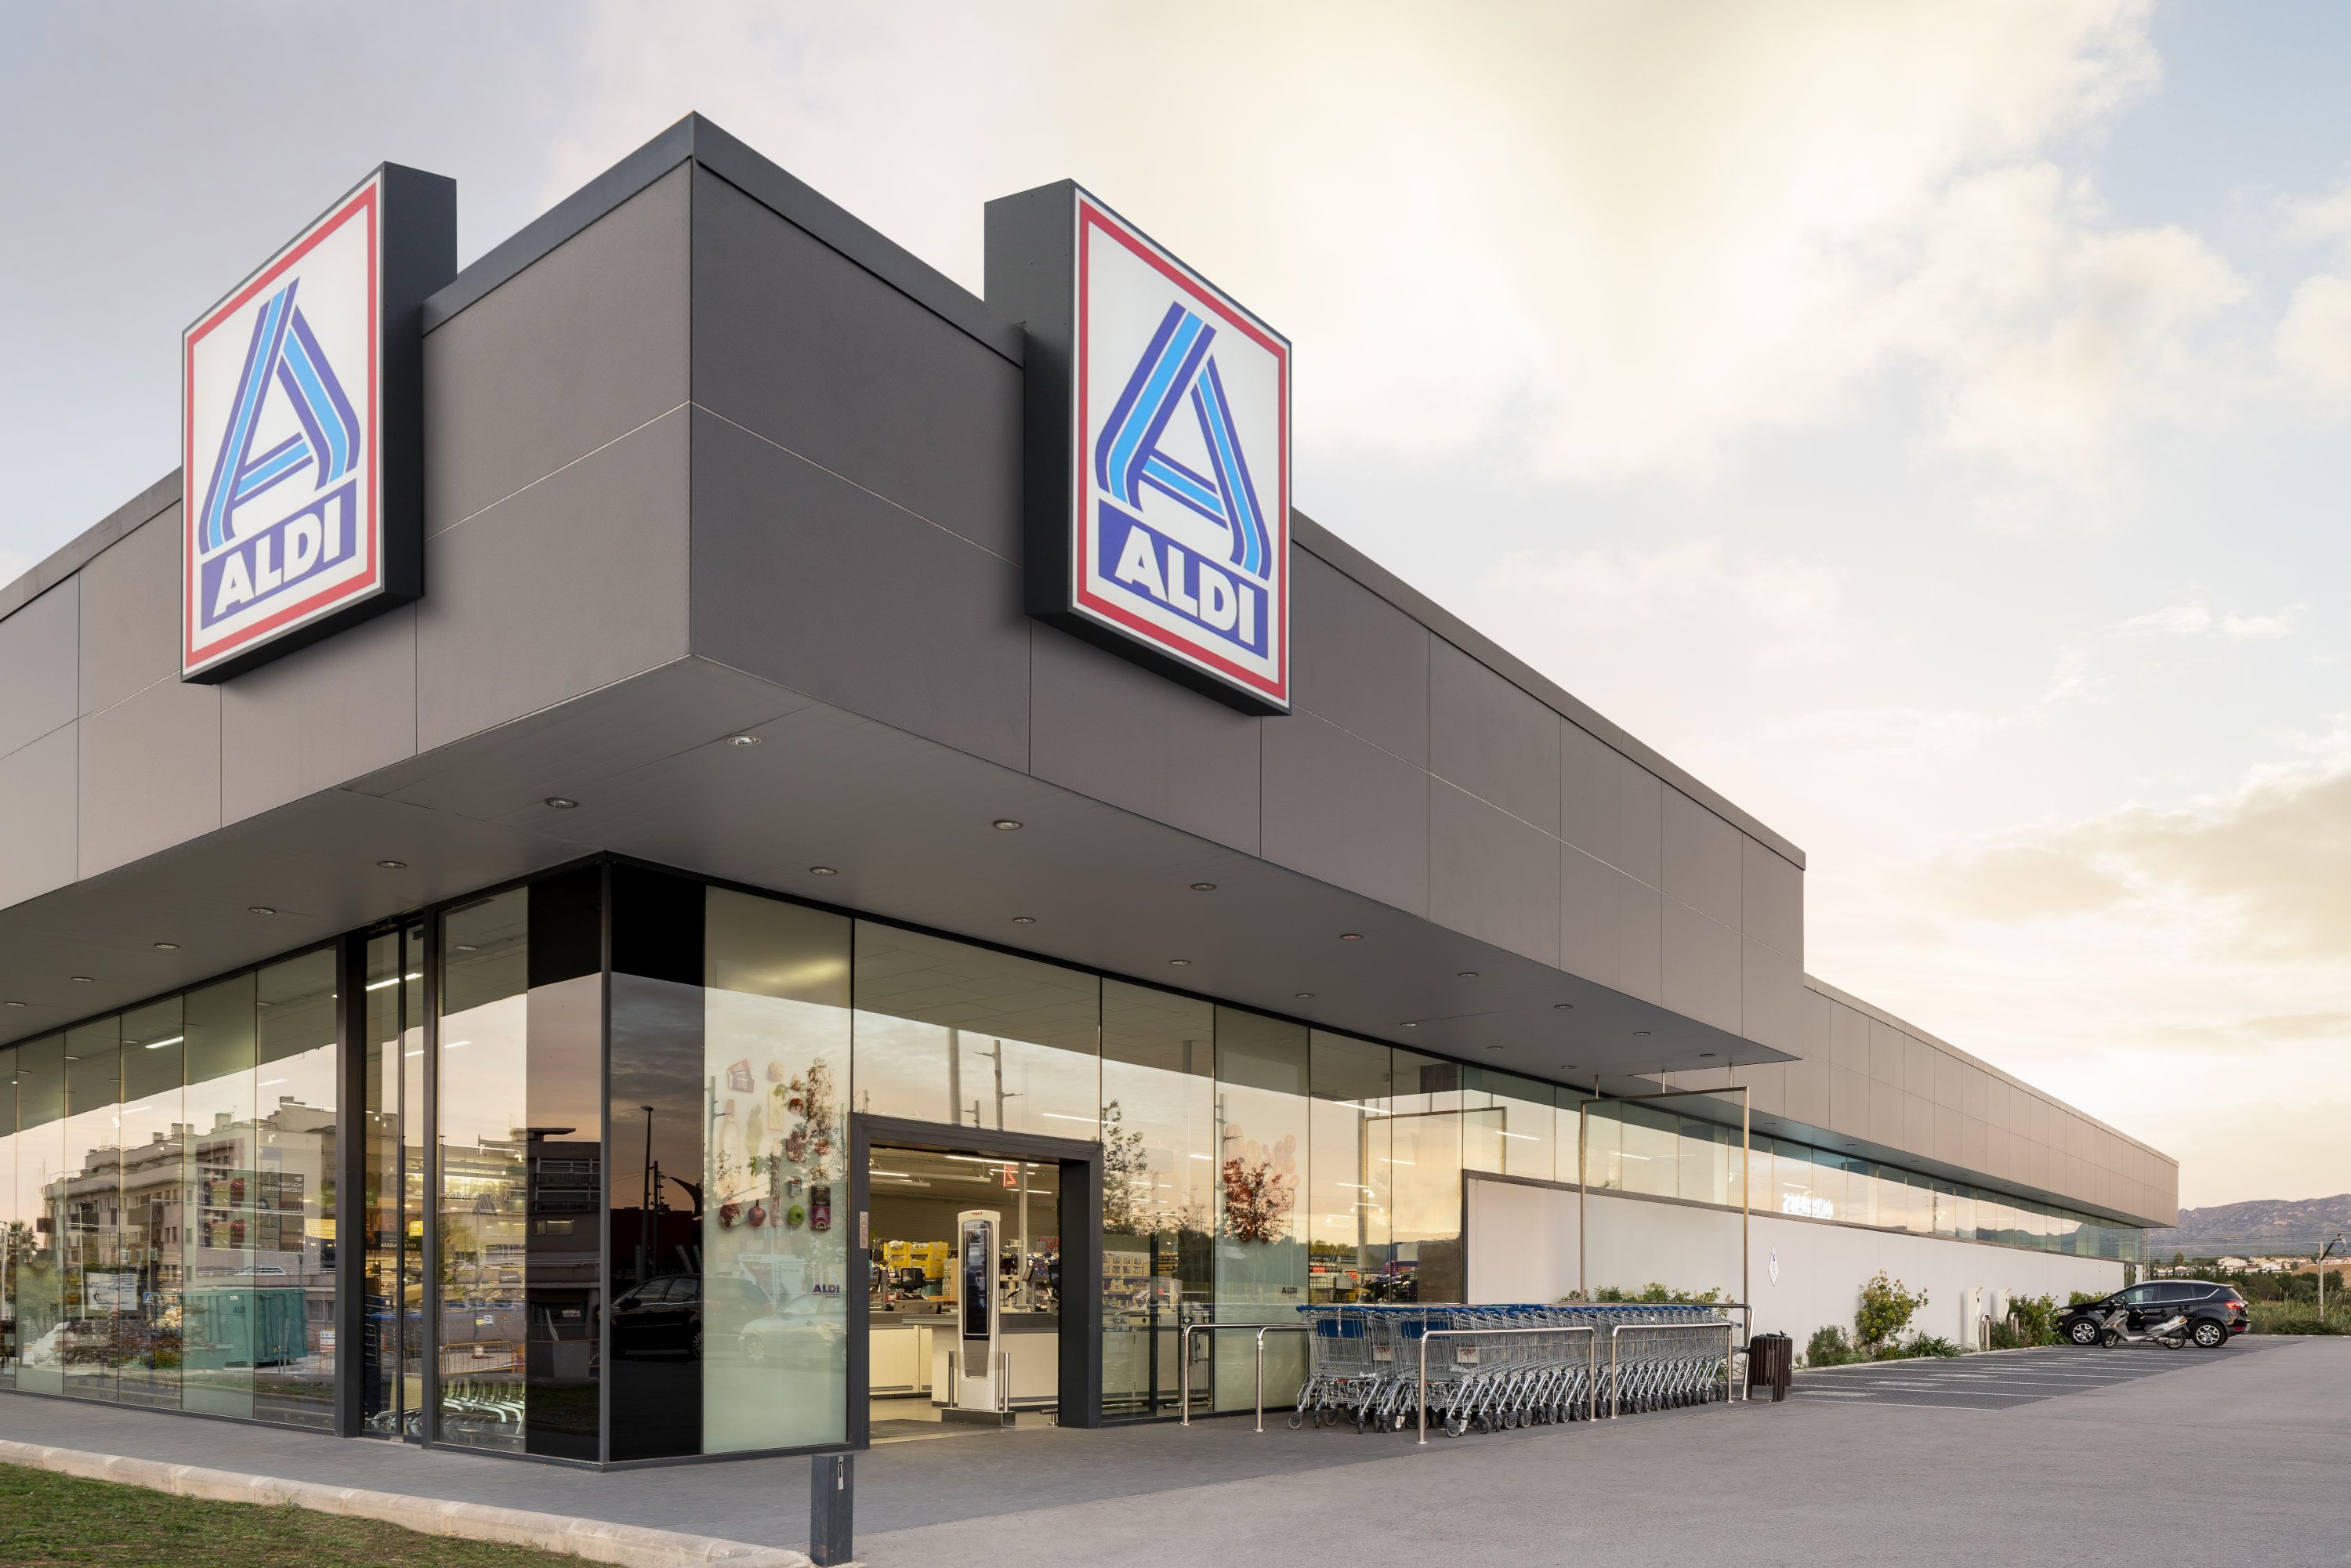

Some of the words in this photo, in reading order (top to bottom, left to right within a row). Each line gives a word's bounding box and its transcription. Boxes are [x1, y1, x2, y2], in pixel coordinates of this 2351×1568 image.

[212, 494, 341, 618] ALDI
[1114, 524, 1255, 646] ALDI
[813, 1284, 840, 1293] ALDI
